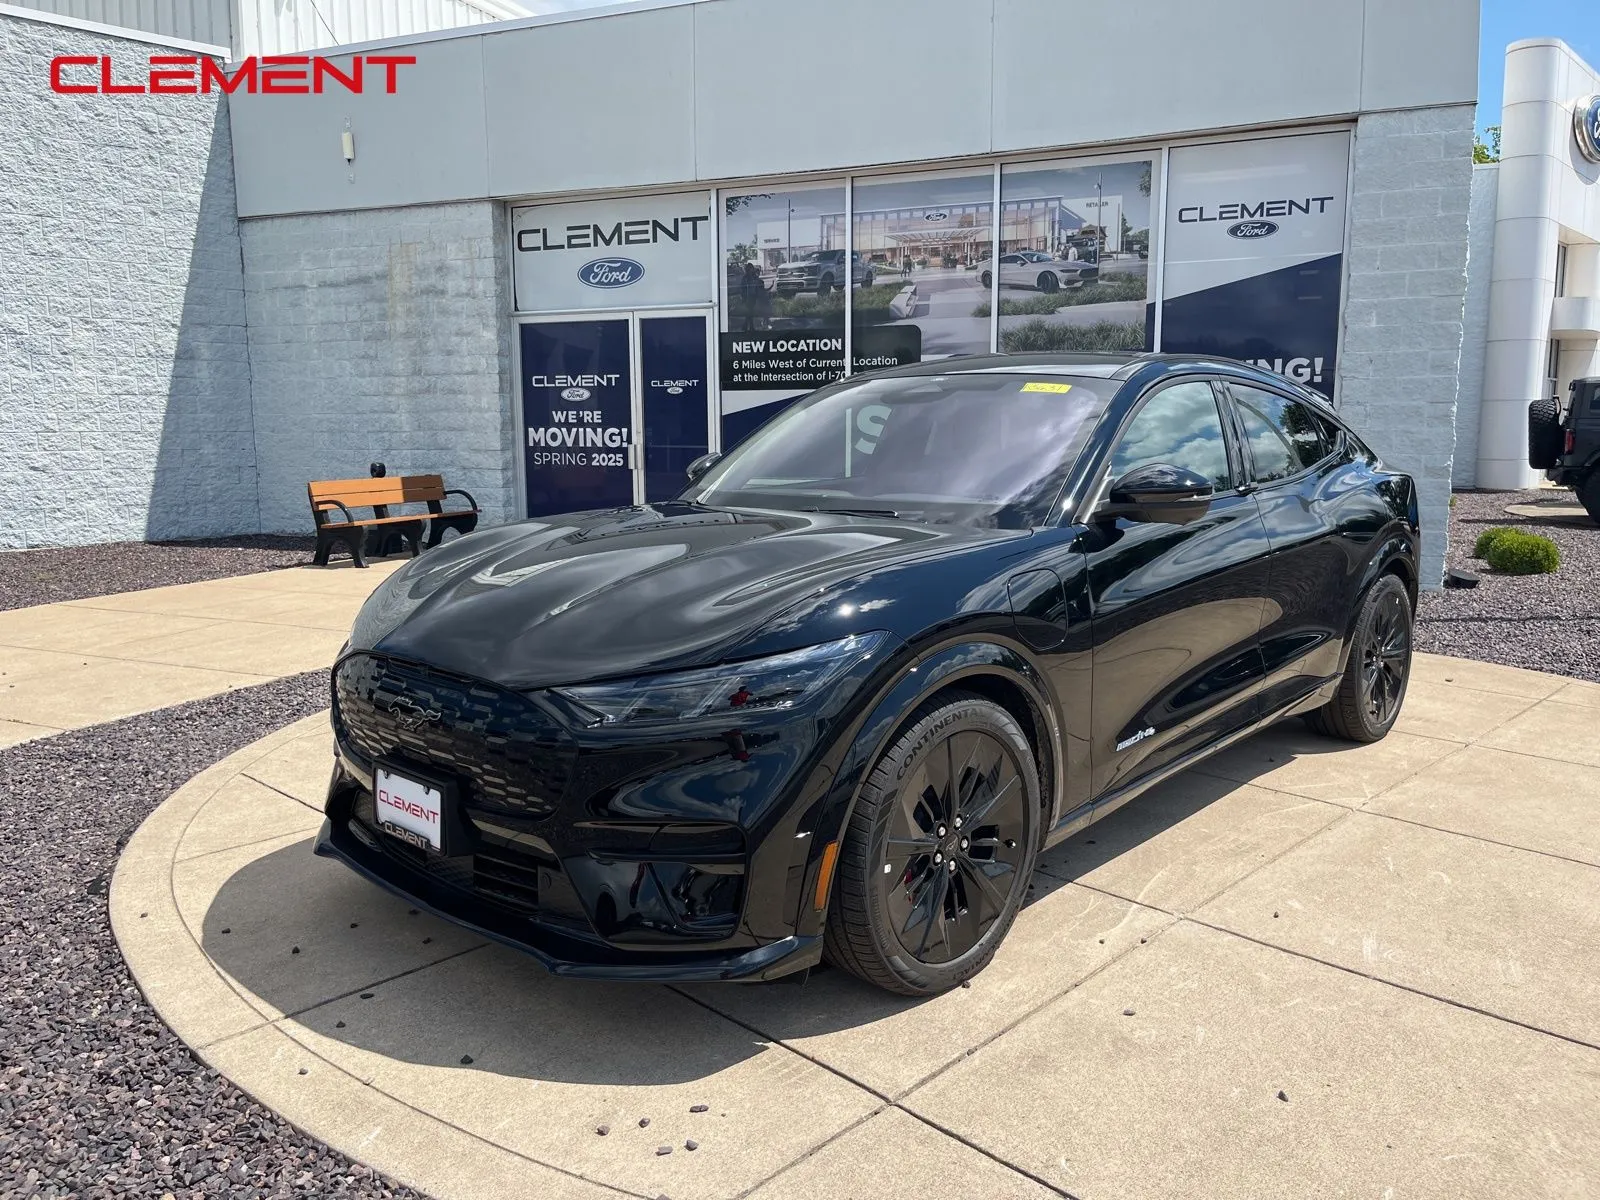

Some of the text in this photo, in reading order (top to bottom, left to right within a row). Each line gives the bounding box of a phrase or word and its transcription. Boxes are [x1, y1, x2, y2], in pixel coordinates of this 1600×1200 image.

[1178, 196, 1334, 223] CLEMENT
[517, 215, 709, 252] CLEMENT
[1236, 223, 1269, 237] Ford
[589, 261, 632, 284] Ford
[732, 338, 842, 354] NEW LOCATION
[732, 360, 740, 370] 6
[741, 359, 766, 369] Miles
[768, 359, 794, 369] West
[796, 358, 807, 368] of
[853, 356, 898, 366] Location
[532, 374, 620, 388] CLEMENT
[651, 379, 700, 387] CLEMENT
[732, 373, 744, 382] at
[744, 371, 759, 382] the
[760, 370, 814, 382] Intersection
[816, 370, 827, 380] of
[552, 410, 602, 423] WE'RE
[528, 427, 628, 448] MOVING!
[533, 452, 624, 467] SPRING 2025
[379, 789, 439, 824] CLEMENT
[384, 821, 429, 849] CLEMENT
